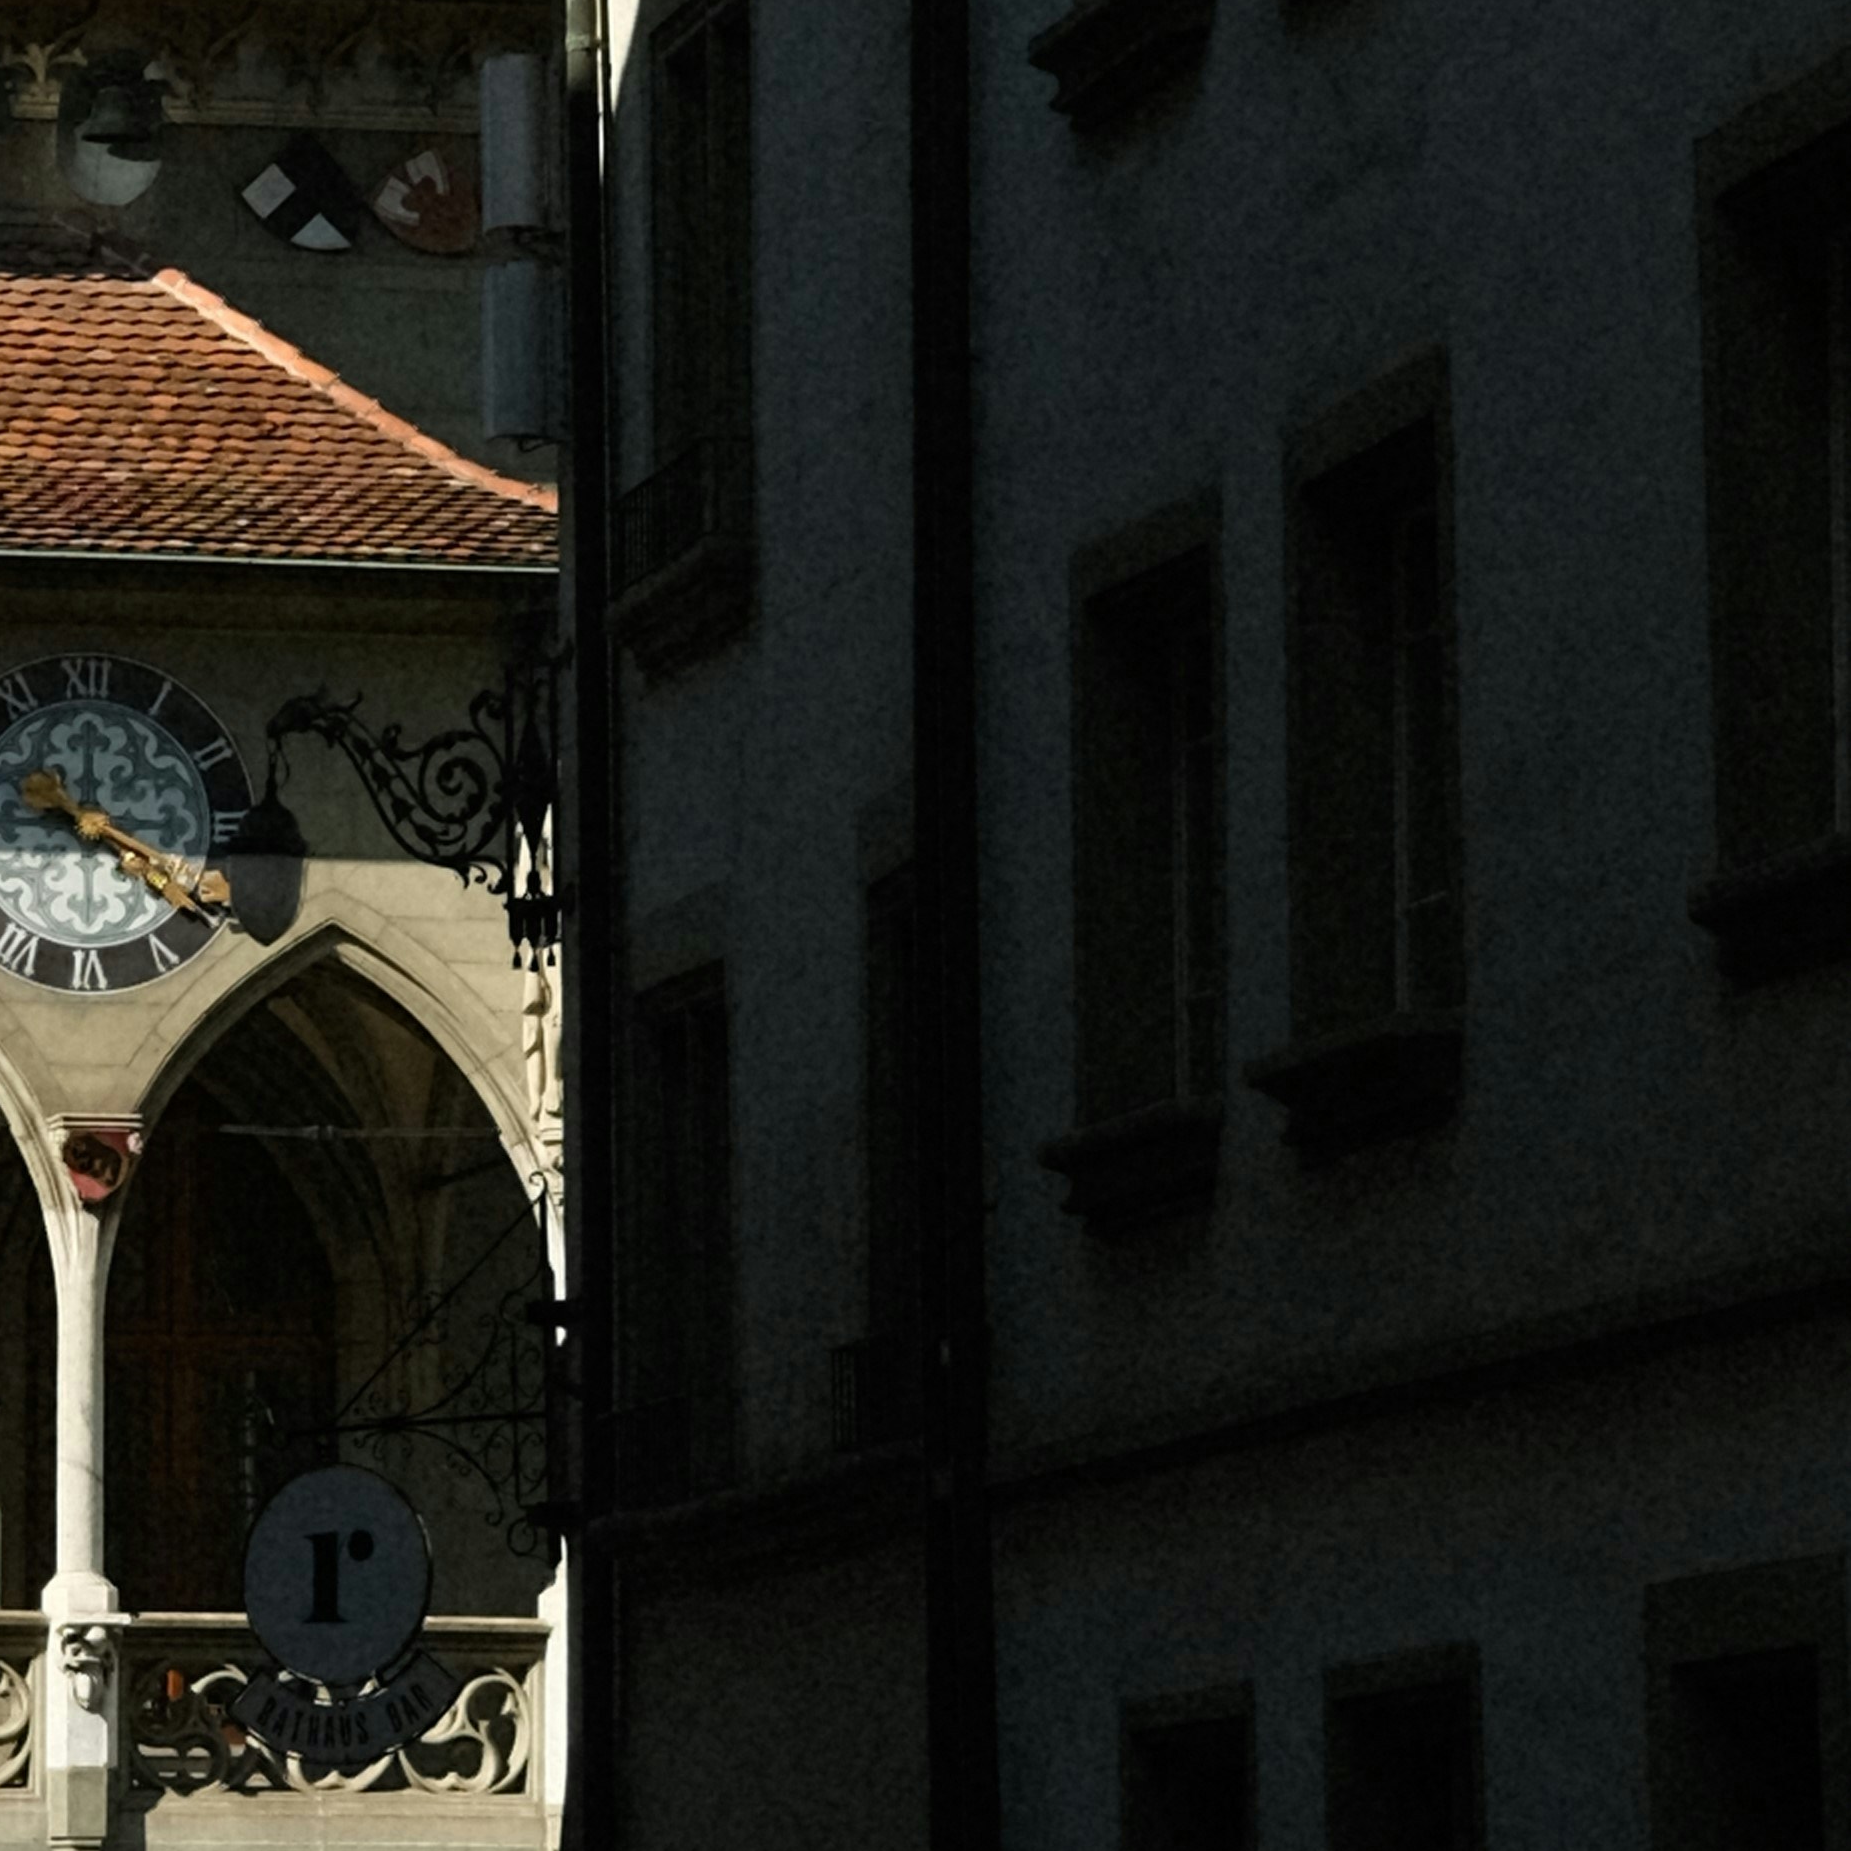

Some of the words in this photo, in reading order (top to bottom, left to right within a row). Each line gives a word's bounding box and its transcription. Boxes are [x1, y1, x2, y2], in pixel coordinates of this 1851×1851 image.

[60, 657, 112, 699] XII
[148, 680, 172, 716] I
[192, 735, 234, 772] II
[256, 1695, 370, 1748] RATHAUS
[385, 1683, 434, 1734] BAR
